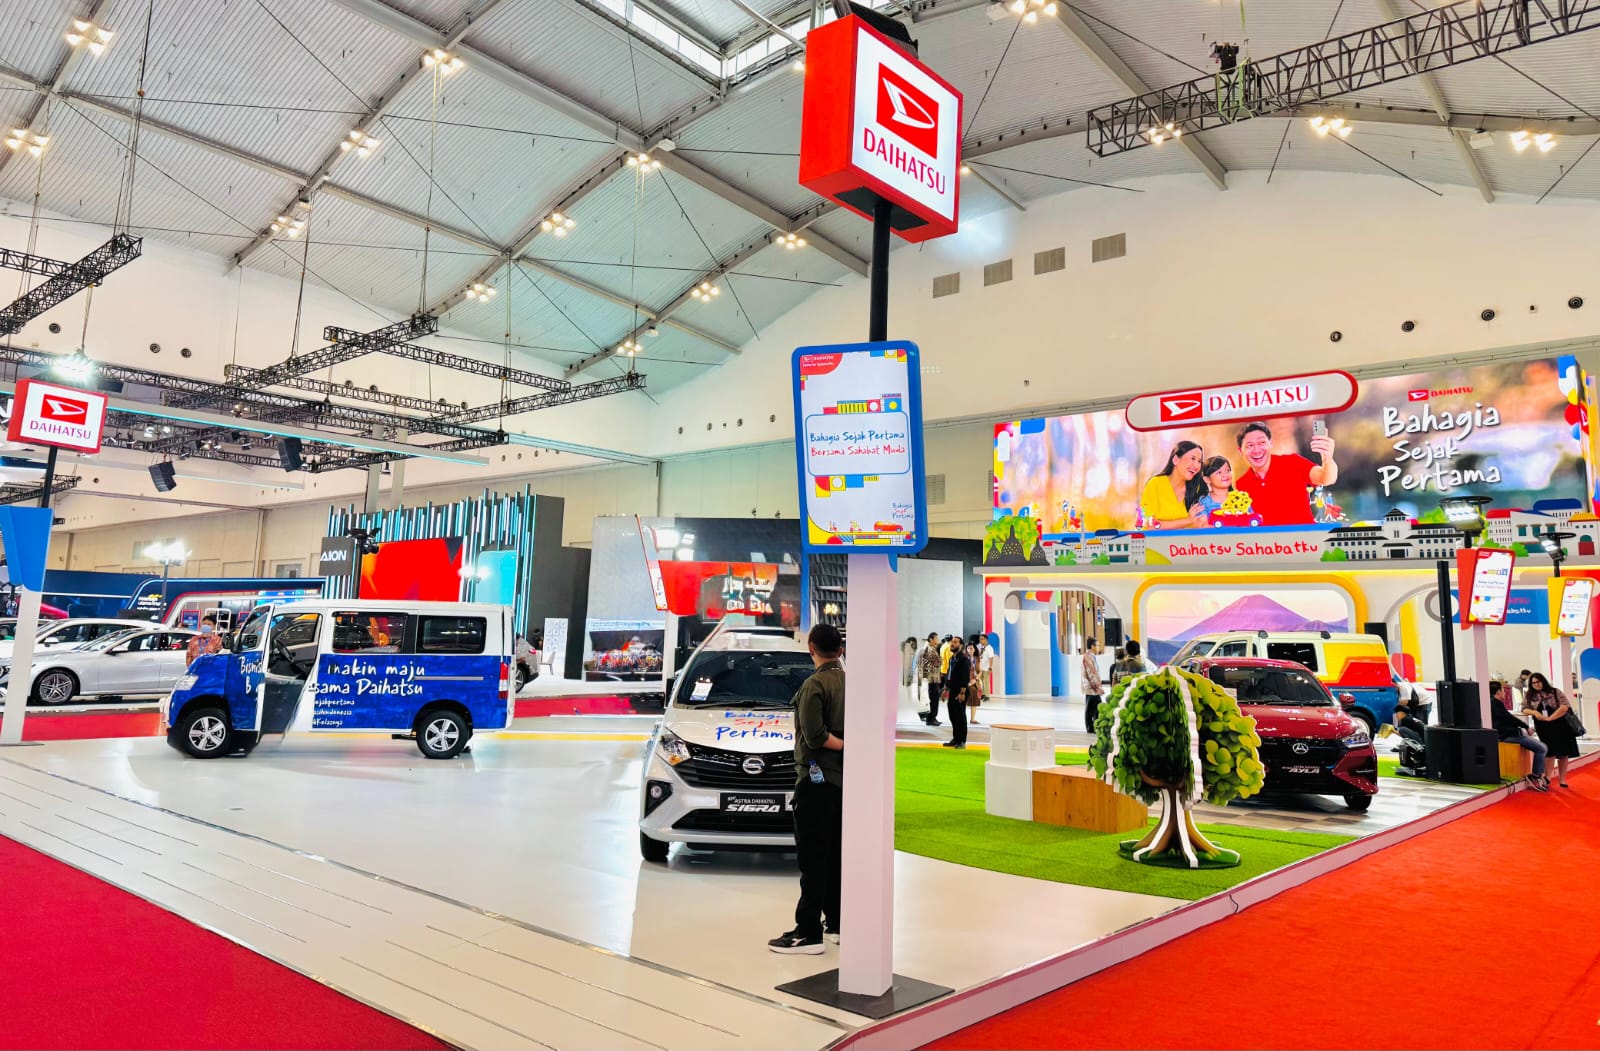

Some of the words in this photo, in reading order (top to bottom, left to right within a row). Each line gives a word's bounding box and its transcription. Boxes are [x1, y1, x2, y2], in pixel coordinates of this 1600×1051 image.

[863, 127, 945, 195] DAIHATSU
[1209, 384, 1309, 412] DAIHATSU
[1431, 387, 1473, 397] DAIHATSU
[29, 420, 92, 440] DAIHATSU
[1383, 403, 1500, 440] Bahagia
[810, 432, 840, 444] Bahagia
[842, 430, 866, 443] Sejak
[868, 429, 905, 441] Pertama
[811, 446, 845, 457] Bersama
[847, 444, 881, 456] Sahabat
[883, 443, 906, 455] Muda
[1393, 437, 1460, 468] Sejak
[1377, 462, 1502, 497] Pertama
[320, 549, 347, 561] AION
[1169, 543, 1232, 558] Daihatsu
[1236, 541, 1319, 556] Sahabatku
[385, 660, 426, 681] maju
[356, 678, 423, 697] Daihatsu
[715, 726, 794, 741] Pertama
[725, 804, 780, 813] SIGRA
